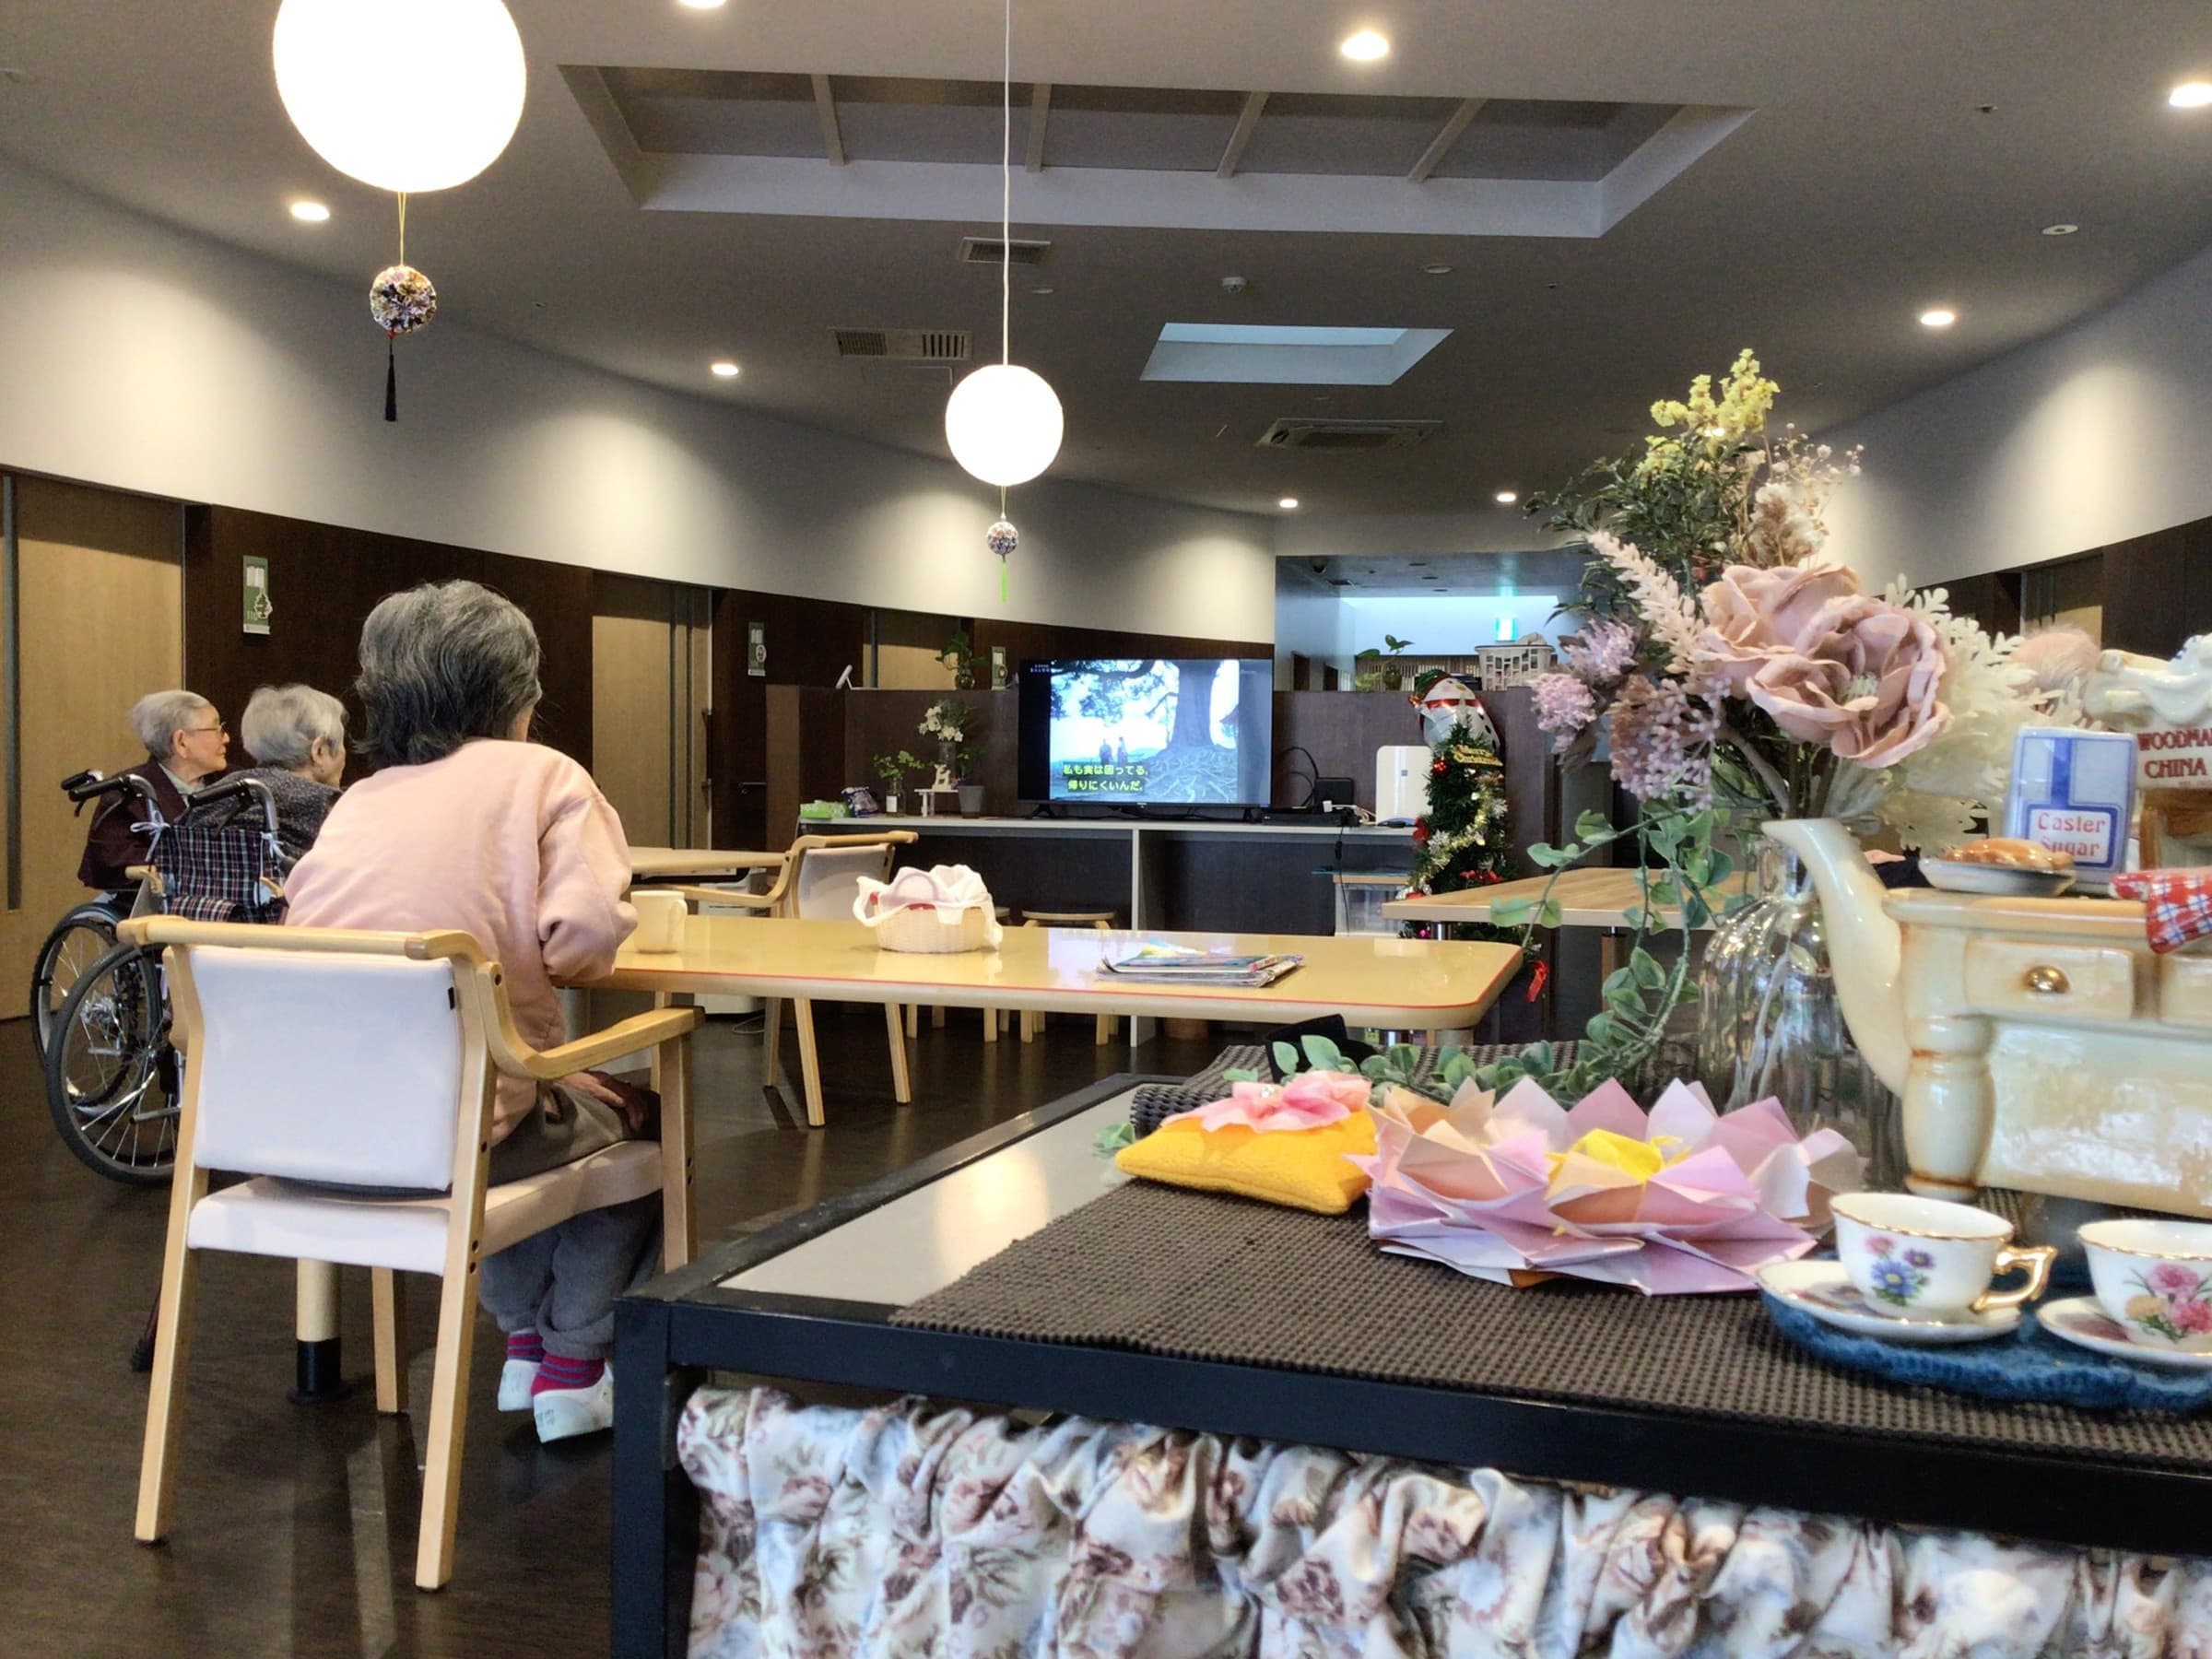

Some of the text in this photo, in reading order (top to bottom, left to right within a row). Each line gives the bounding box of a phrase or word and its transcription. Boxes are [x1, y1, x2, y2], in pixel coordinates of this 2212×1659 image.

[2136, 728, 2212, 751] WOODMA
[2145, 758, 2207, 779] CHINA
[2038, 812, 2105, 833] Caster
